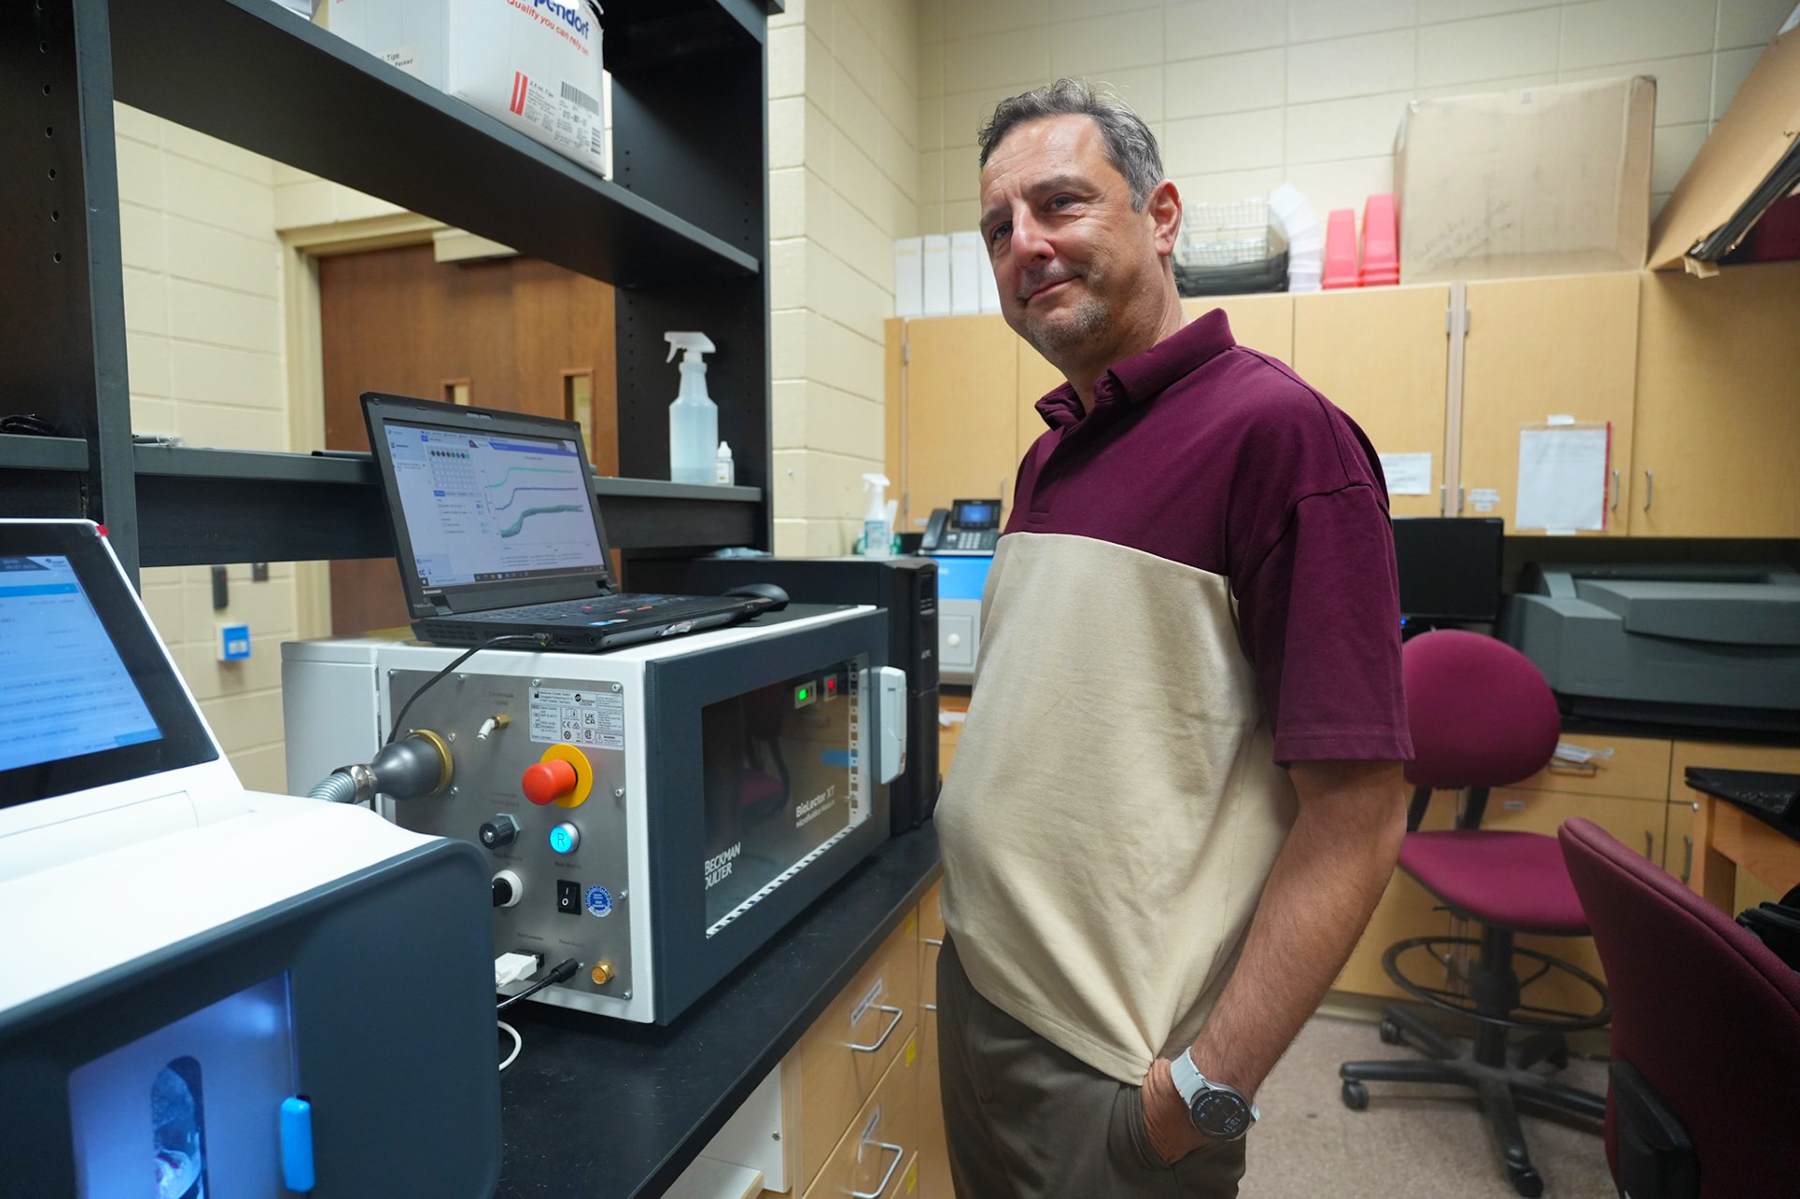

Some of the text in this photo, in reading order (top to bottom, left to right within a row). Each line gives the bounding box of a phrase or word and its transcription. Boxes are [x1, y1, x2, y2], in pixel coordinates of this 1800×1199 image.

[523, 0, 589, 39] pendorf
[540, 16, 555, 30] you
[555, 26, 569, 40] can
[704, 841, 741, 877] BECKMAN
